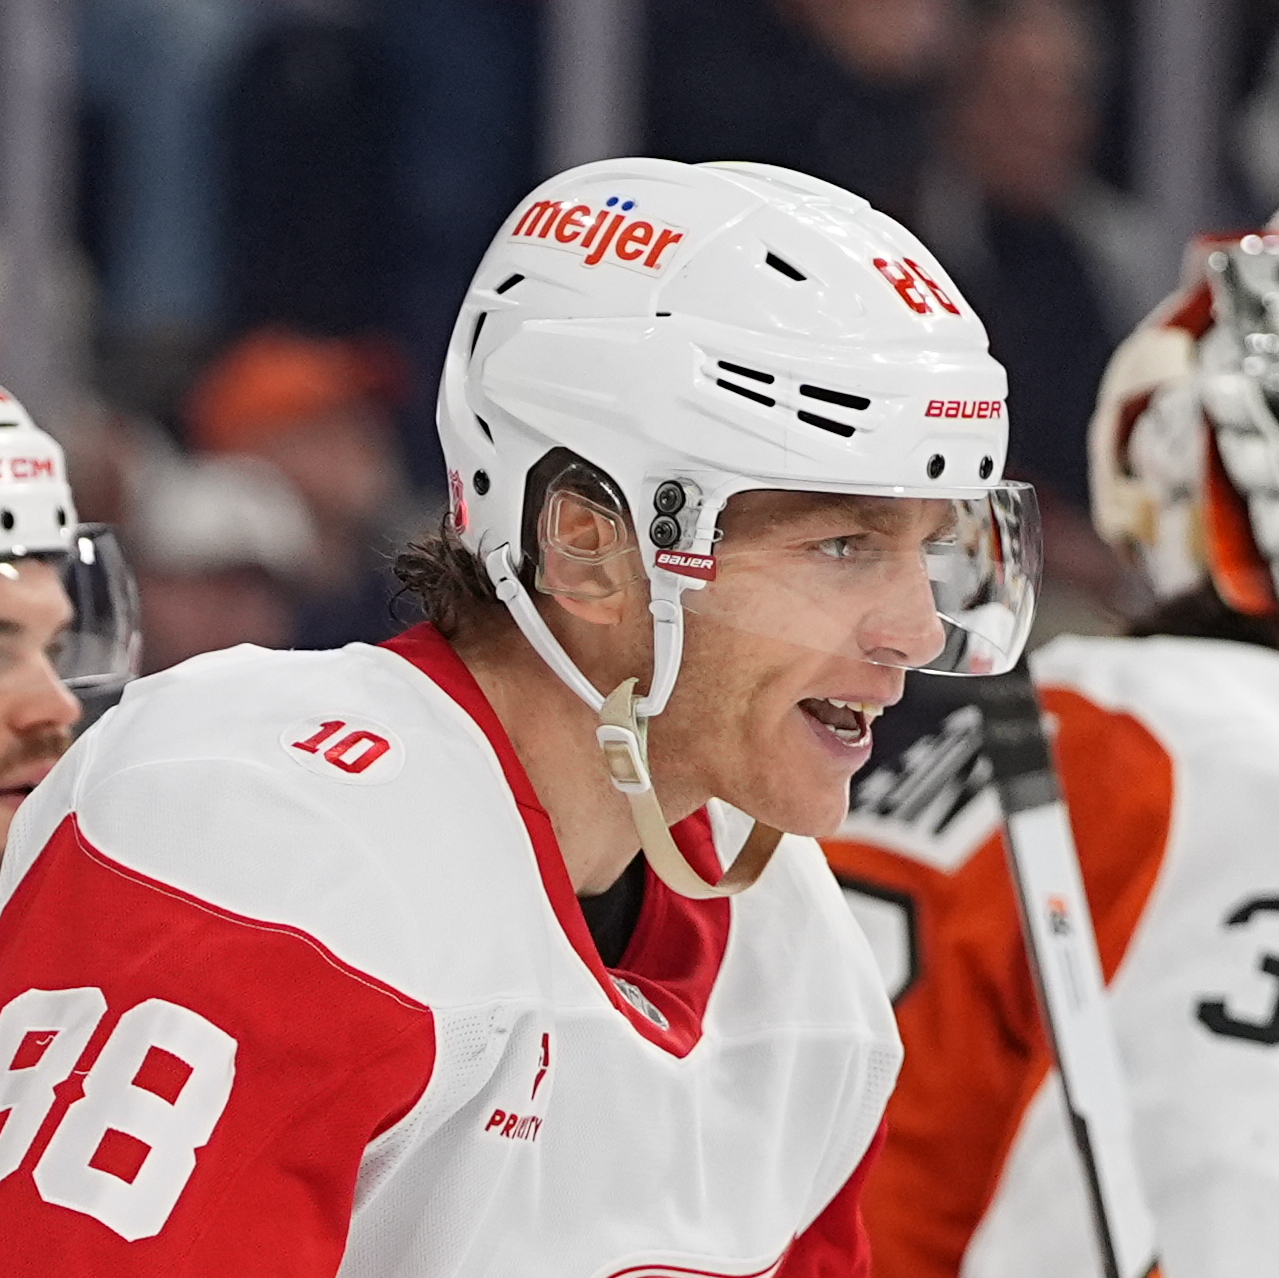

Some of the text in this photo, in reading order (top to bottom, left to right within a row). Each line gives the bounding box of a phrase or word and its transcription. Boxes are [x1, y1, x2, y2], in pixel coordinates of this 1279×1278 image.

[511, 196, 684, 268] meijer
[924, 400, 1002, 419] BAUER
[657, 553, 714, 569] BAUER
[290, 719, 391, 774] 10
